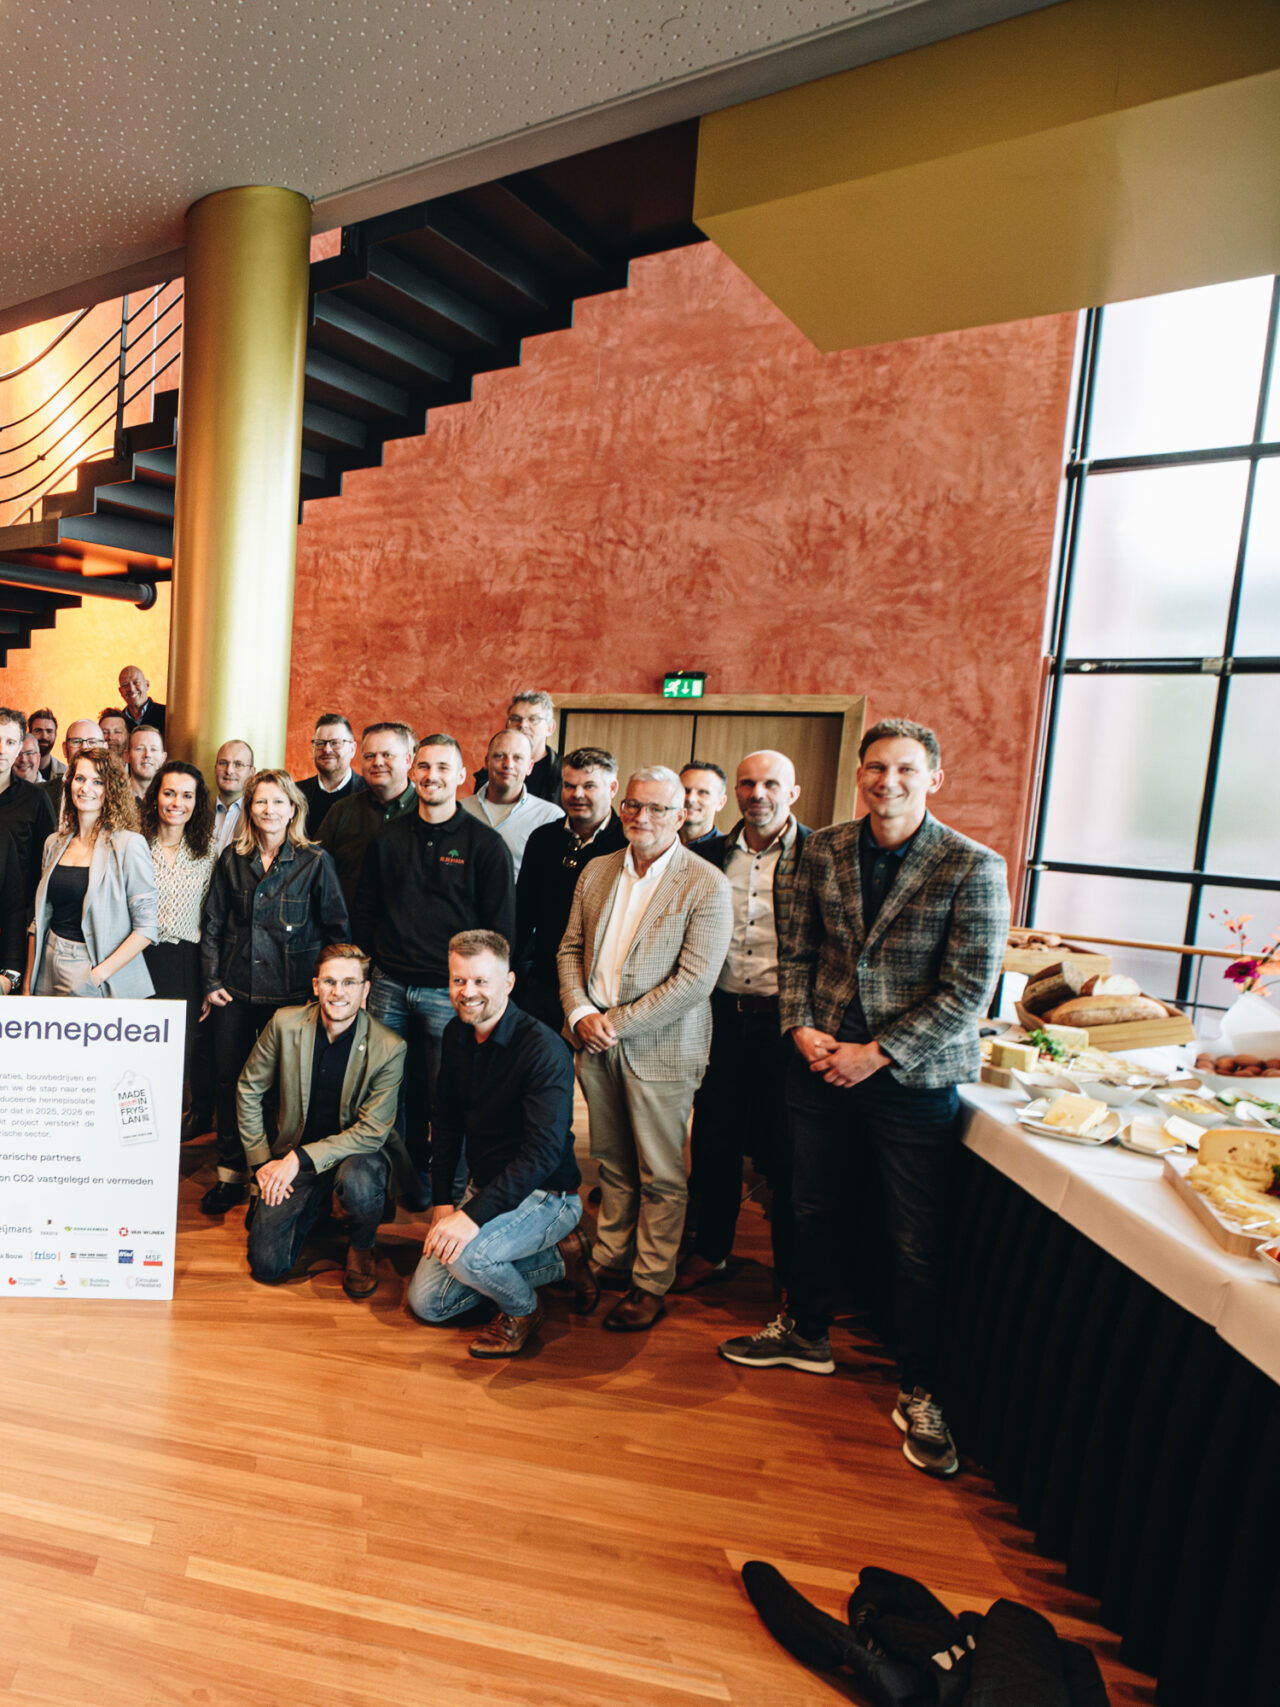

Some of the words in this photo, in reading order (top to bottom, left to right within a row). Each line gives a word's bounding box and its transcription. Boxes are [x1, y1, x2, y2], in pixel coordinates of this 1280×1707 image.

[26, 1073, 84, 1082] bouwbedrijven
[26, 1084, 37, 1092] de
[39, 1085, 58, 1093] stap
[118, 1089, 146, 1100] MADE
[39, 1097, 96, 1105] hennepisolatie
[138, 1097, 147, 1105] IN
[61, 1108, 83, 1116] 2026
[121, 1106, 148, 1116] FRYS-
[11, 1119, 40, 1128] project
[84, 1120, 95, 1128] de
[40, 1154, 81, 1162] partners
[12, 1174, 35, 1183] CO2
[37, 1175, 90, 1186] vastgelegd
[106, 1177, 154, 1185] vermeden
[34, 1251, 56, 1260] friso
